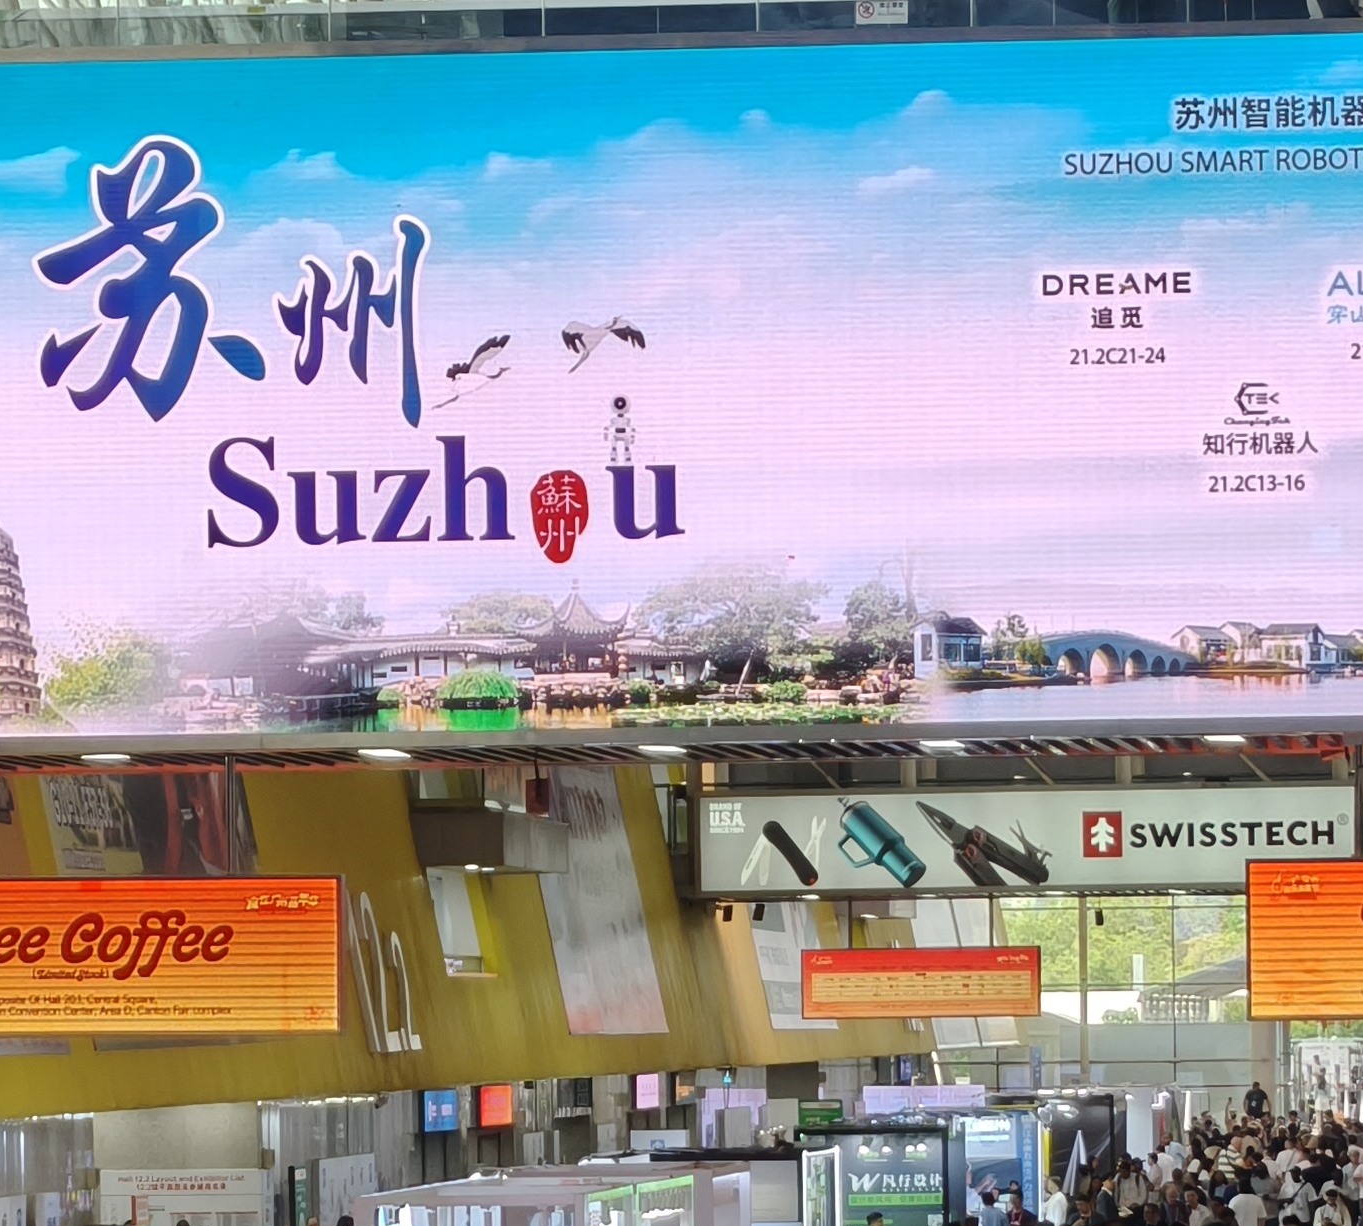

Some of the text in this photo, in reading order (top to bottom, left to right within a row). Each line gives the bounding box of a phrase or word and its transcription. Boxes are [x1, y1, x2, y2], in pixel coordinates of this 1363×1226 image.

[1065, 151, 1173, 175] SUZHOU
[1181, 149, 1269, 173] SMART
[36, 137, 427, 428] 苏州
[1043, 271, 1192, 297] DREAME
[1069, 346, 1166, 365] 21.2C21-24
[1203, 431, 1319, 455] 知行机器人
[207, 434, 685, 548] Suzhu
[1208, 474, 1305, 492] 21.2C13-16
[1129, 821, 1334, 848] SWISSTECH
[60, 909, 234, 980] Coffee
[8, 1006, 61, 1016] Convention
[99, 1006, 121, 1015] Area
[137, 1006, 170, 1015] Canton
[87, 994, 119, 1004] Central
